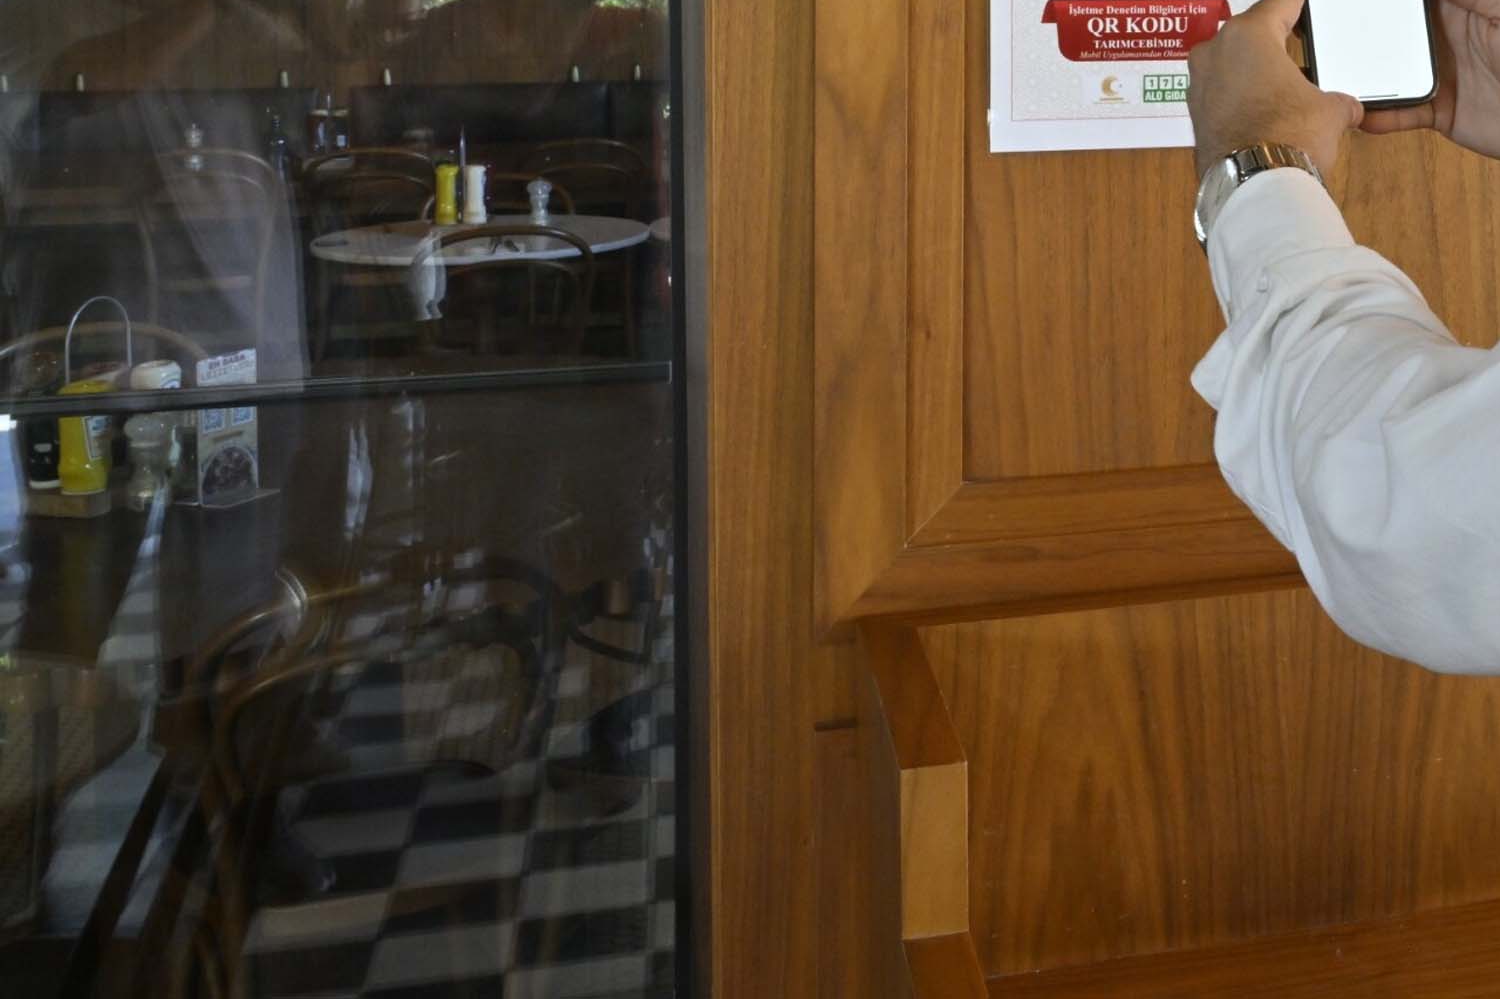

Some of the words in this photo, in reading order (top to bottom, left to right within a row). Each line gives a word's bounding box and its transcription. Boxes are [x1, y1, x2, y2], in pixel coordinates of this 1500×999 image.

[1068, 3, 1104, 16] İşletme
[1106, 5, 1146, 15] Denetim
[1149, 4, 1187, 16] Bilgileri
[1189, 2, 1207, 15] İçin
[1087, 16, 1120, 37] QR
[1126, 16, 1188, 33] KODU
[1094, 37, 1184, 49] TARIMCEBİMDE
[1145, 91, 1162, 101] ALO
[1164, 91, 1187, 101] GIDA
